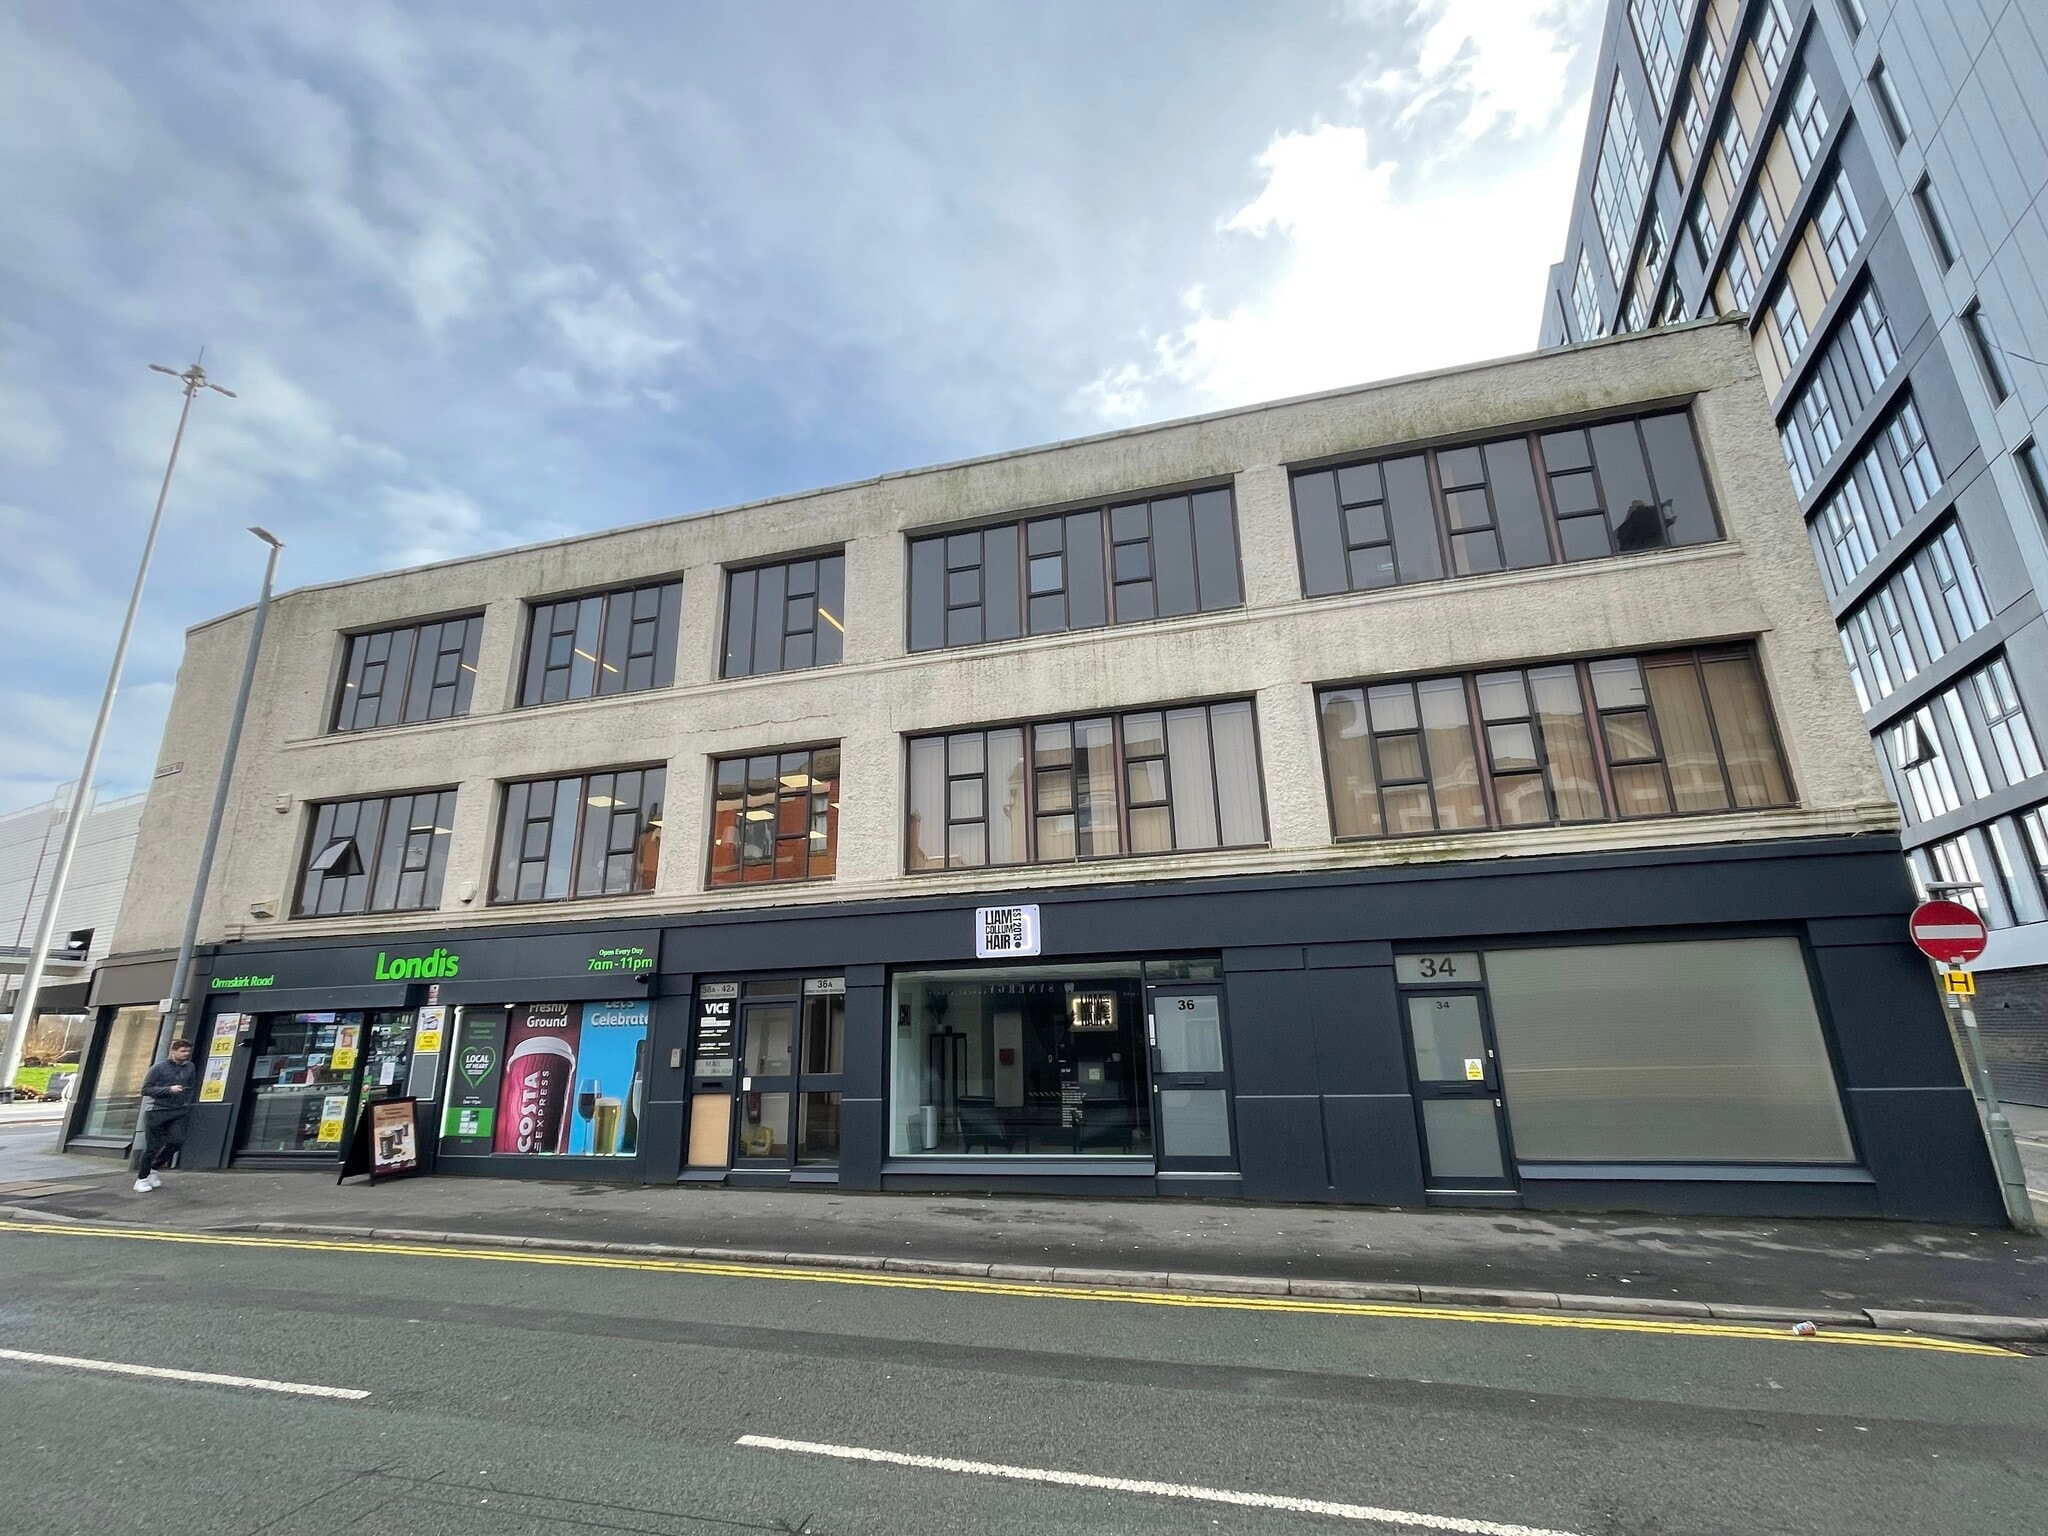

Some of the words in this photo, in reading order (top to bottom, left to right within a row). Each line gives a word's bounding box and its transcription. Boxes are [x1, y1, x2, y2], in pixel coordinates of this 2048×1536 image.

[985, 909, 1012, 925] LIAM
[1013, 908, 1021, 921] EST
[985, 925, 1013, 934] COLLUM
[1013, 923, 1022, 941] 2013
[986, 935, 1010, 950] HAIR
[599, 949, 614, 957] Open
[615, 948, 630, 956] Every
[631, 947, 644, 955] Day
[375, 948, 460, 980] Londis
[1420, 957, 1456, 978] 34
[212, 976, 249, 988] Ormskirk
[250, 975, 274, 987] Road
[818, 980, 833, 989] 36A
[1948, 972, 1971, 992] H
[722, 984, 735, 993] 42A
[705, 1003, 730, 1014] VICE
[1178, 1000, 1195, 1010] 36
[1436, 1001, 1450, 1009] 34
[526, 1015, 568, 1028] Ground
[535, 1070, 550, 1139] EXPRESS
[517, 1071, 541, 1153] COSTA
